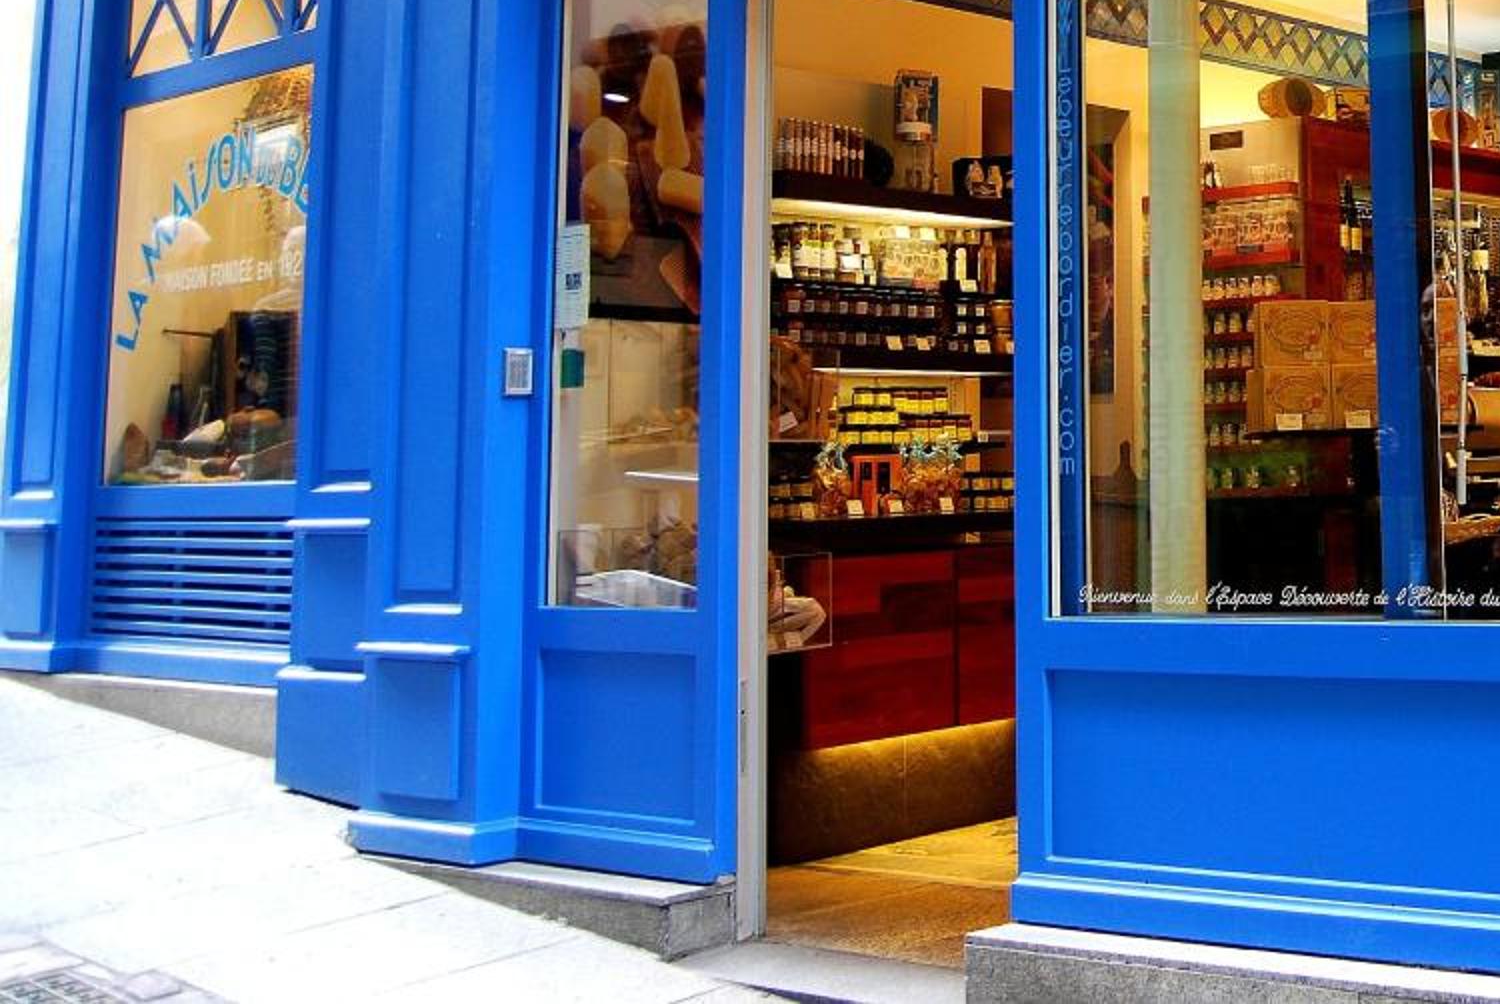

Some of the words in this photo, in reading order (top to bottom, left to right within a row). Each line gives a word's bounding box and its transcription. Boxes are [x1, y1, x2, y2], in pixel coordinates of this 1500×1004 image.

[115, 290, 149, 351] LA
[1078, 583, 1154, 605] Bienvenue
[1279, 584, 1370, 608] Découverte
[1373, 591, 1390, 606] de
